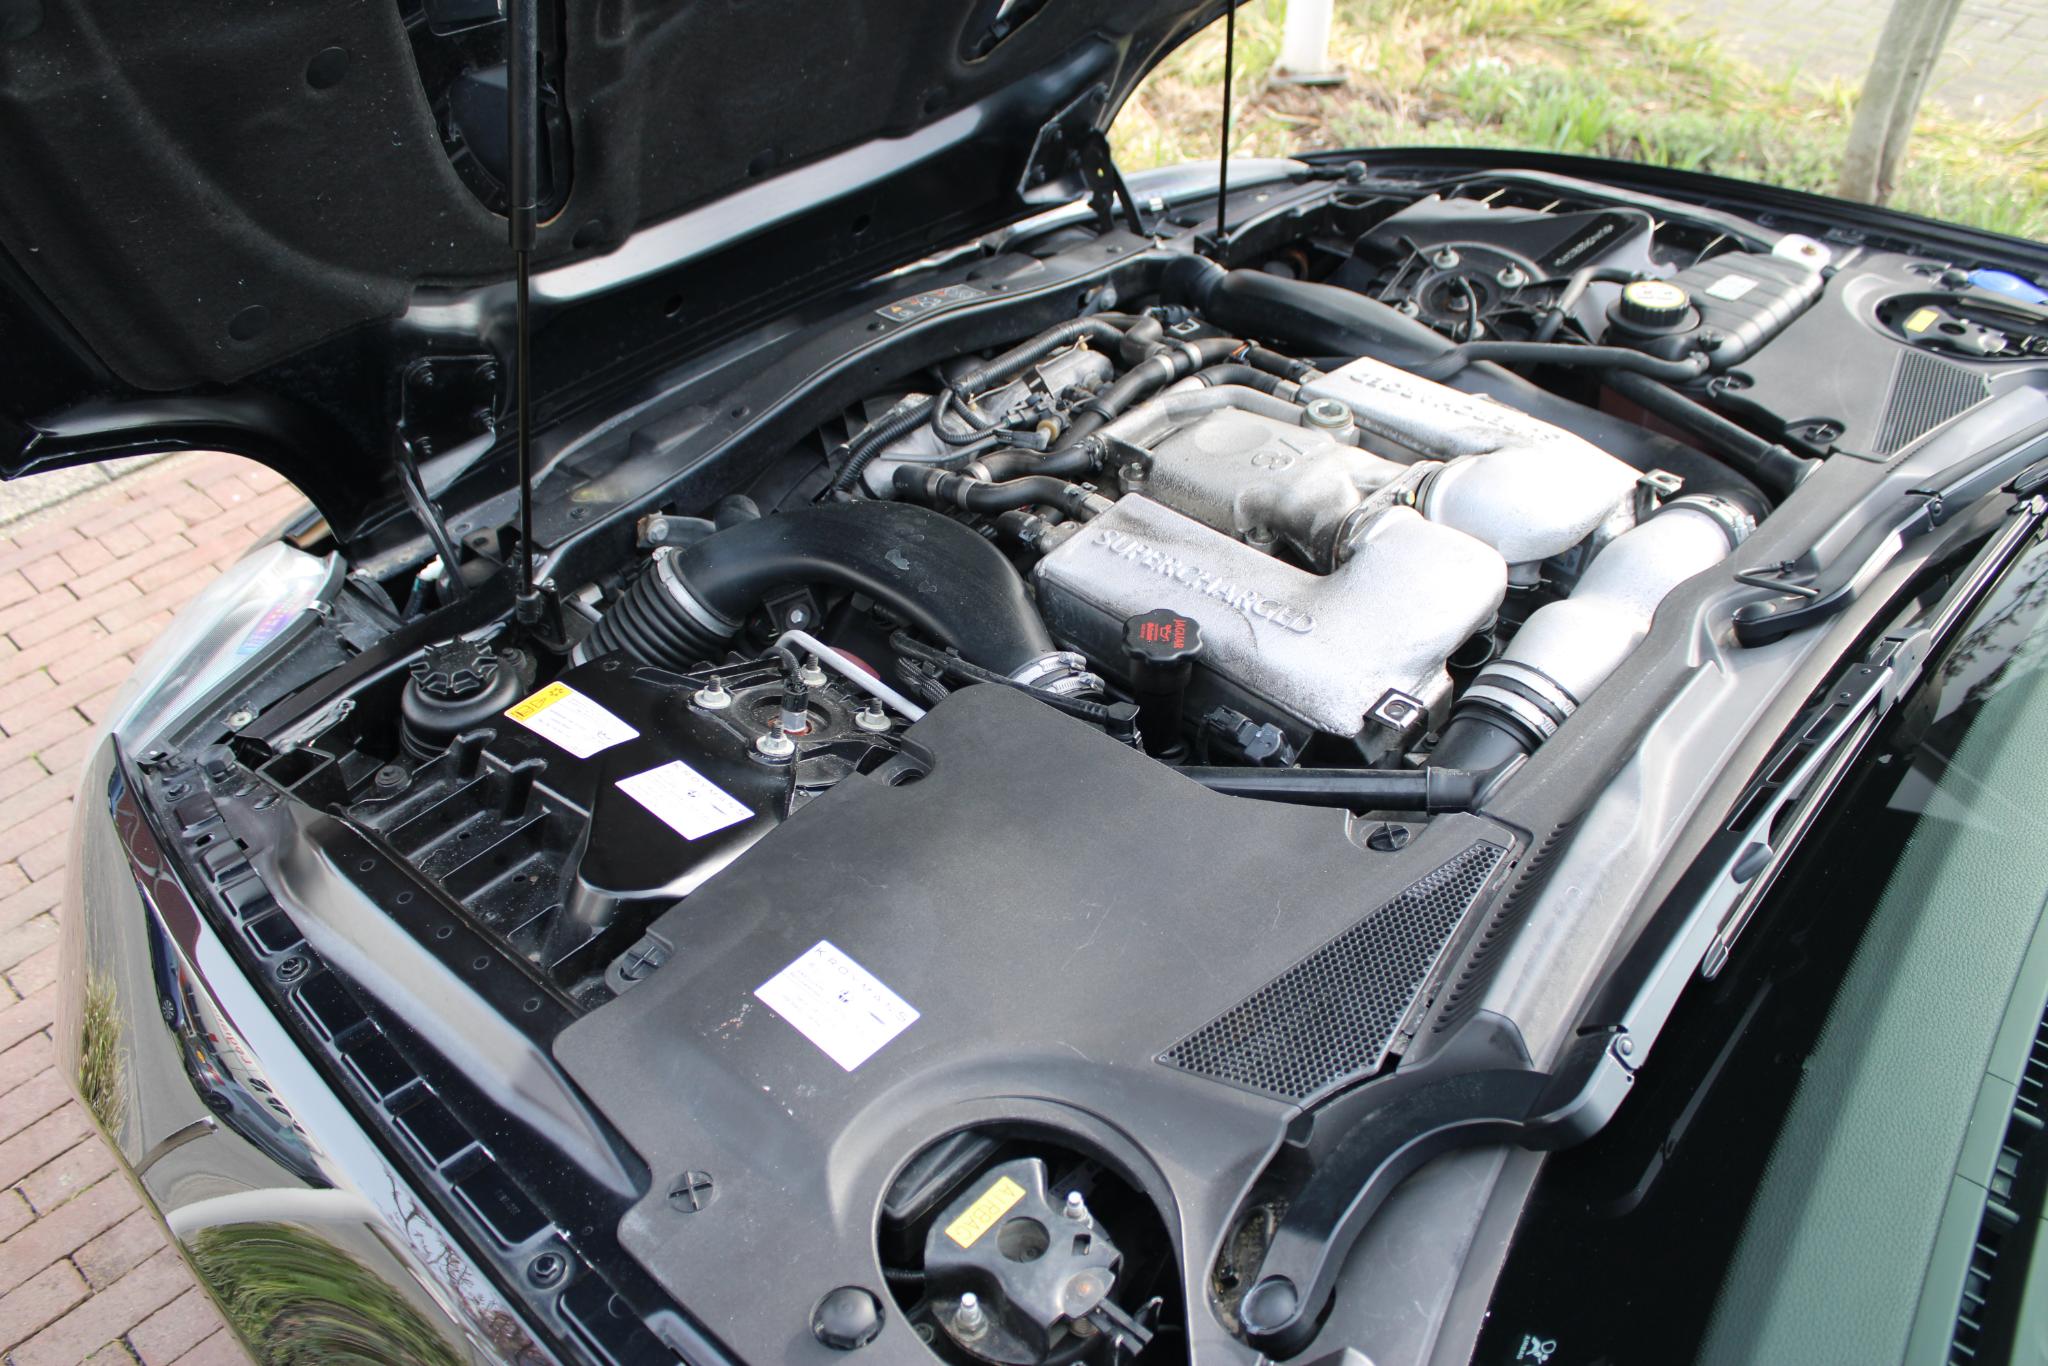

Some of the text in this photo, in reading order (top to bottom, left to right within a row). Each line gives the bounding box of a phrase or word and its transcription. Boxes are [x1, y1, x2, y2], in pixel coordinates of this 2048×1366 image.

[1091, 530, 1315, 634] SUPERCHARGED
[1173, 619, 1186, 648] JAGUAR
[955, 1183, 1016, 1241] AIRBAG
